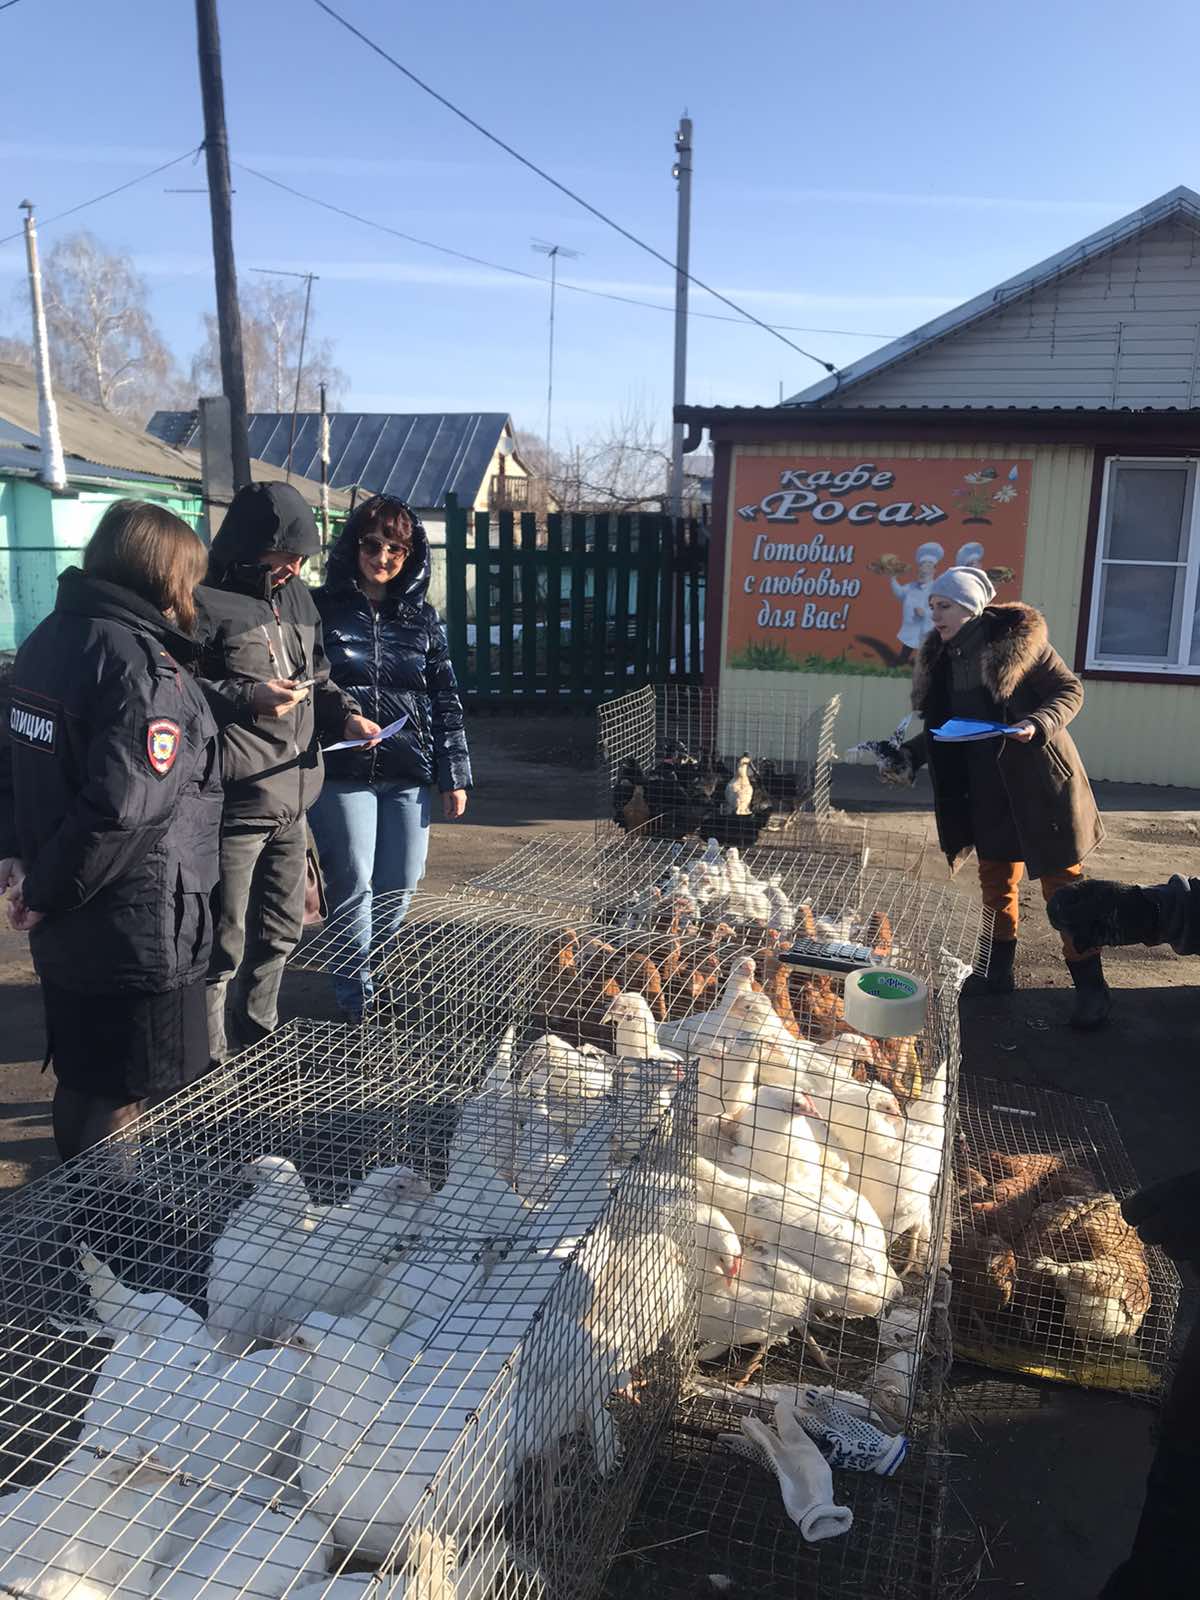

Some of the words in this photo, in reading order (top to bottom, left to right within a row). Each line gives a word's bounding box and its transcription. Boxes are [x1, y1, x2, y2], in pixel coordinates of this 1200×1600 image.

[780, 463, 894, 493] кафе
[737, 490, 946, 522] «Роса»
[752, 533, 855, 564] Готовим
[743, 575, 756, 594] с
[759, 567, 861, 597] любовью
[757, 599, 797, 627] для
[801, 602, 849, 630] Вас!
